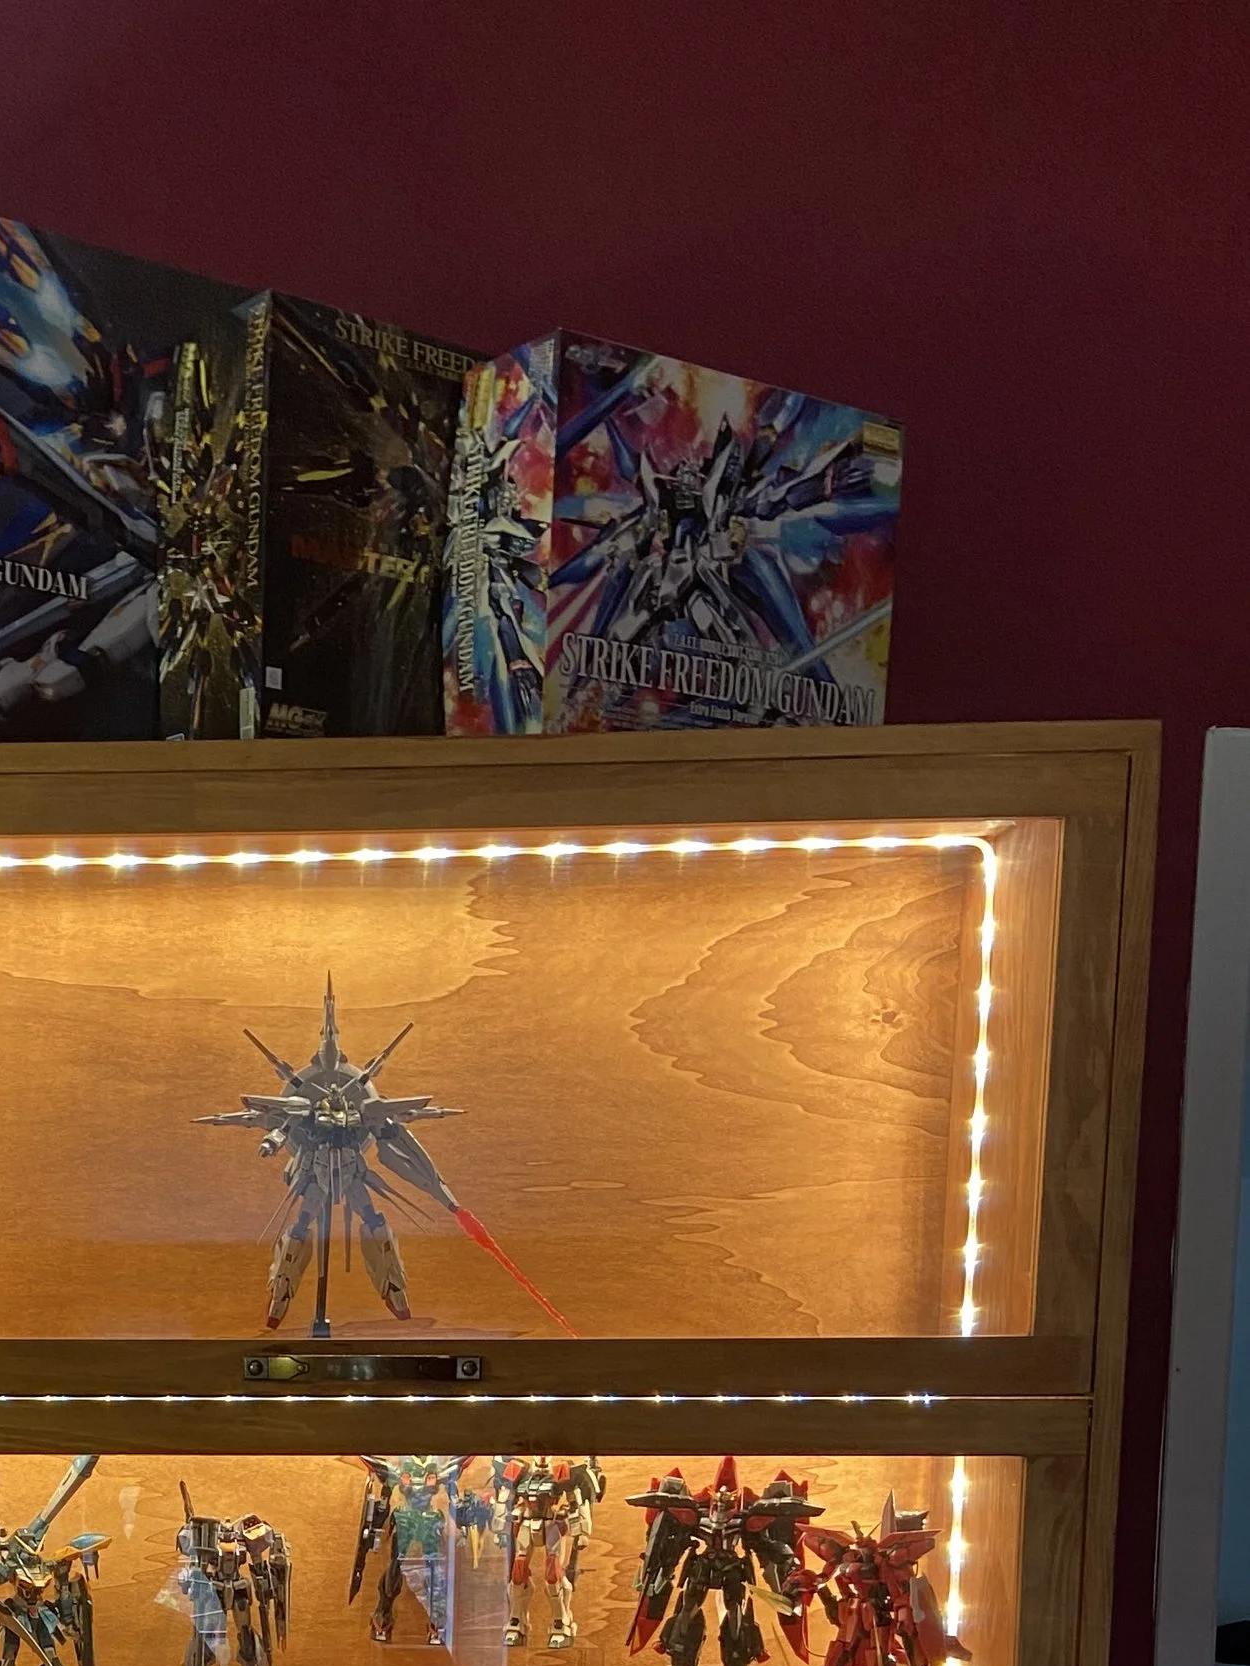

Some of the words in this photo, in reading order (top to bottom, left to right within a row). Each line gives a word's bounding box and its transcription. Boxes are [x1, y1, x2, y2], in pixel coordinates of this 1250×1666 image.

[335, 318, 410, 359] STRIKE
[245, 491, 261, 587] GUNDAM
[458, 604, 476, 693] GUNDAM
[561, 631, 654, 688] STRIKE
[658, 648, 773, 709] FREEDOM
[776, 671, 876, 726] GUNDAM
